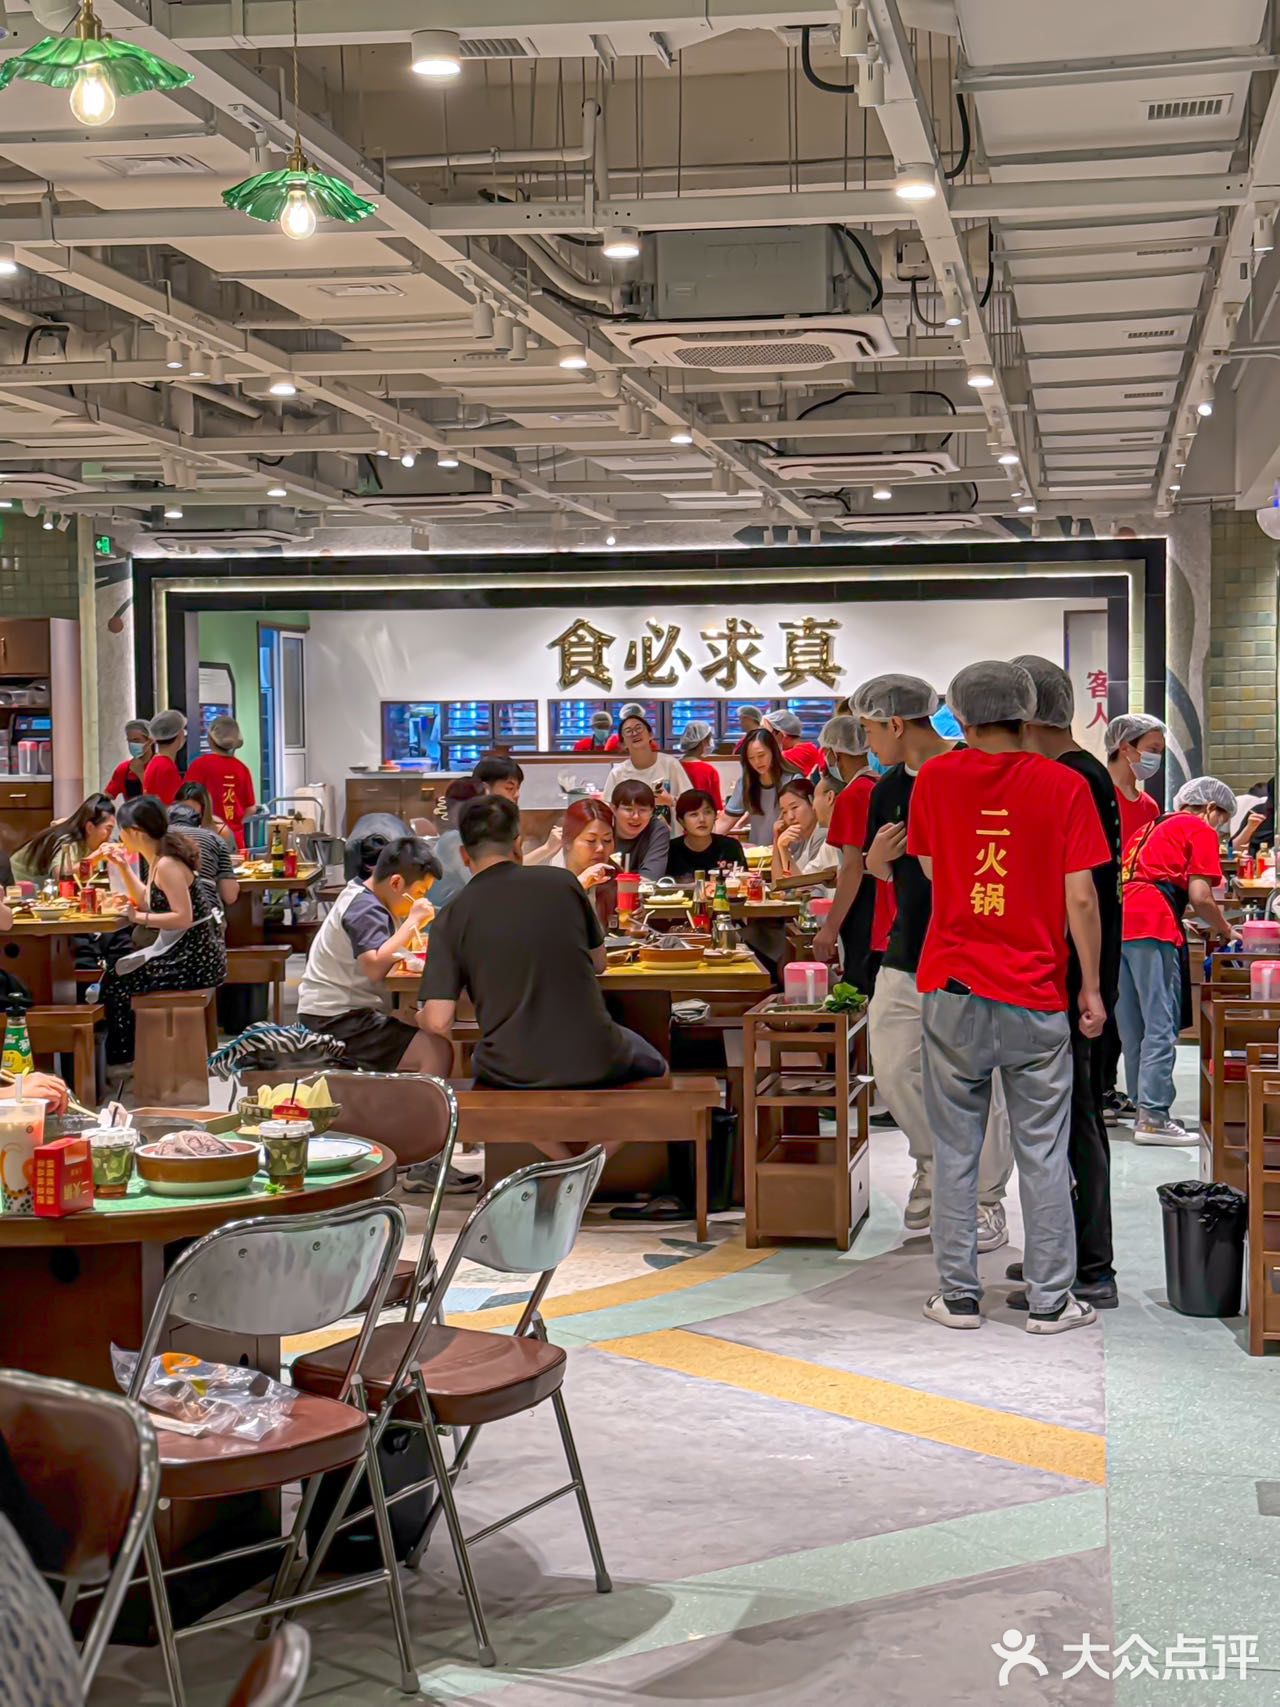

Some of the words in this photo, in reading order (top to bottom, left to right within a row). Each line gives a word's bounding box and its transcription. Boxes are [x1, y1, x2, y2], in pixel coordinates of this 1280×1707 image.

[547, 617, 845, 692] 食必求真
[969, 807, 1011, 917] 二火锅
